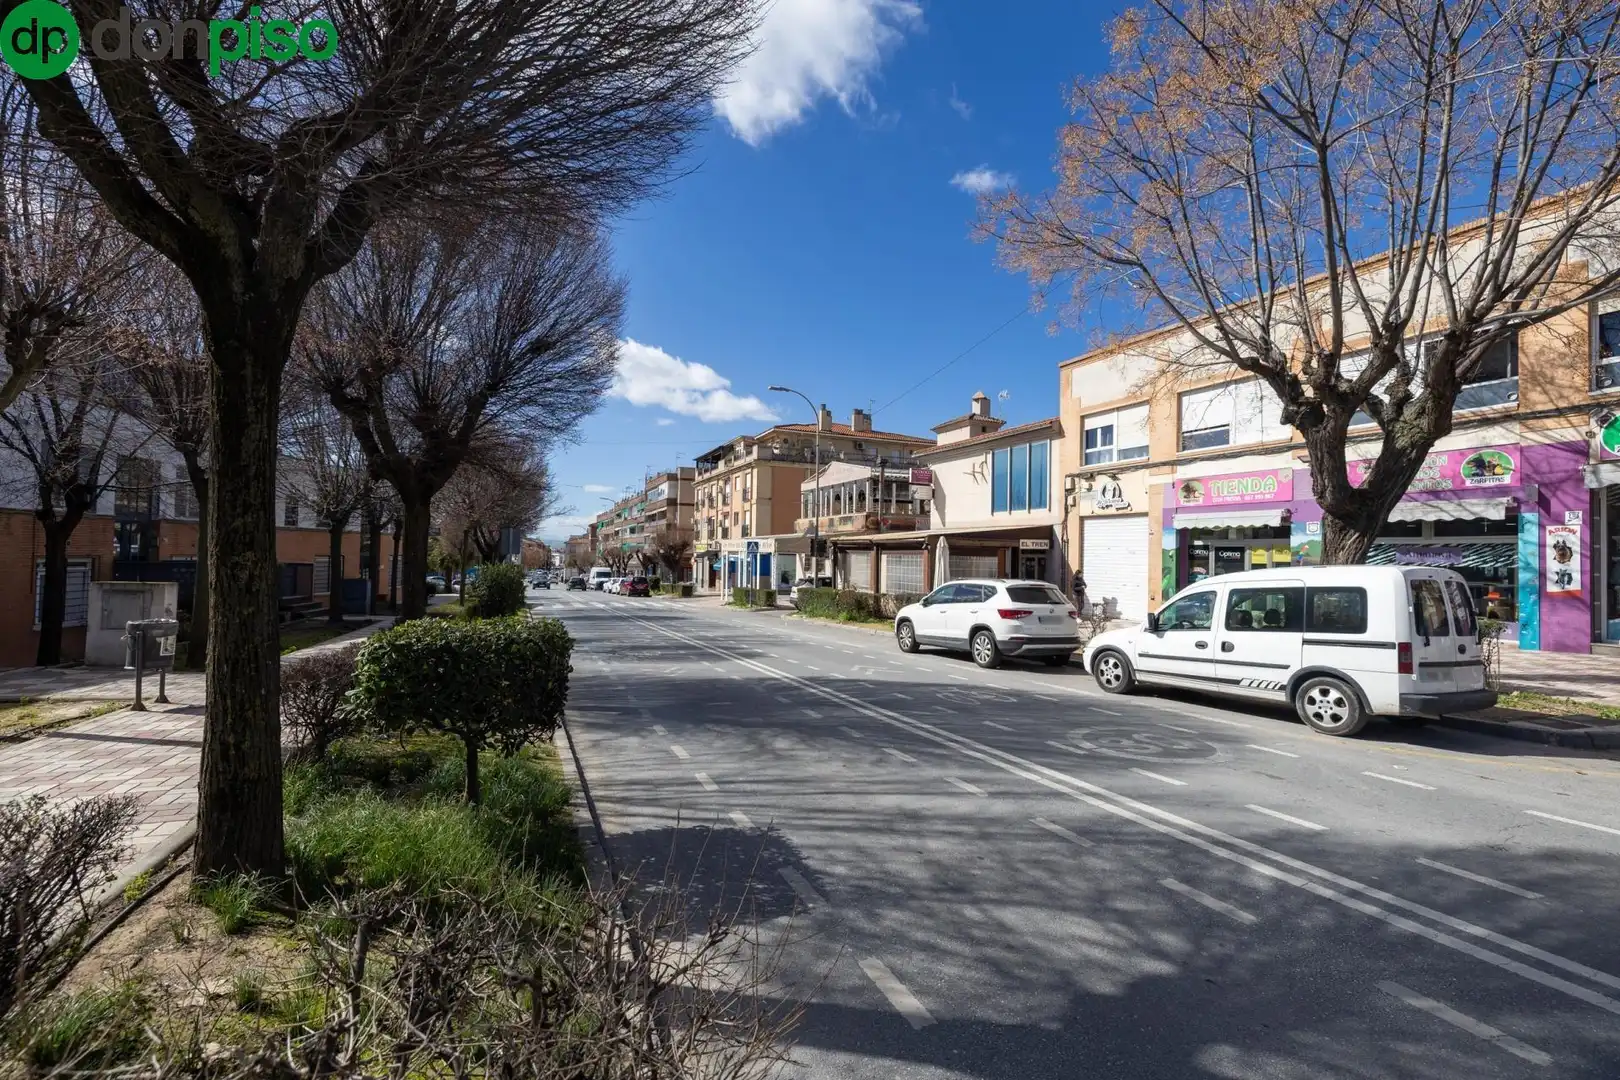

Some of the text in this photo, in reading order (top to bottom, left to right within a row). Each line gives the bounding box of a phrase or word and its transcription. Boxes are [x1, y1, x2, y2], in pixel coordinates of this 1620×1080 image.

[1209, 475, 1277, 496] TIENDA
[1469, 476, 1506, 485] ZARPITAS
[1548, 526, 1578, 536] ARION
